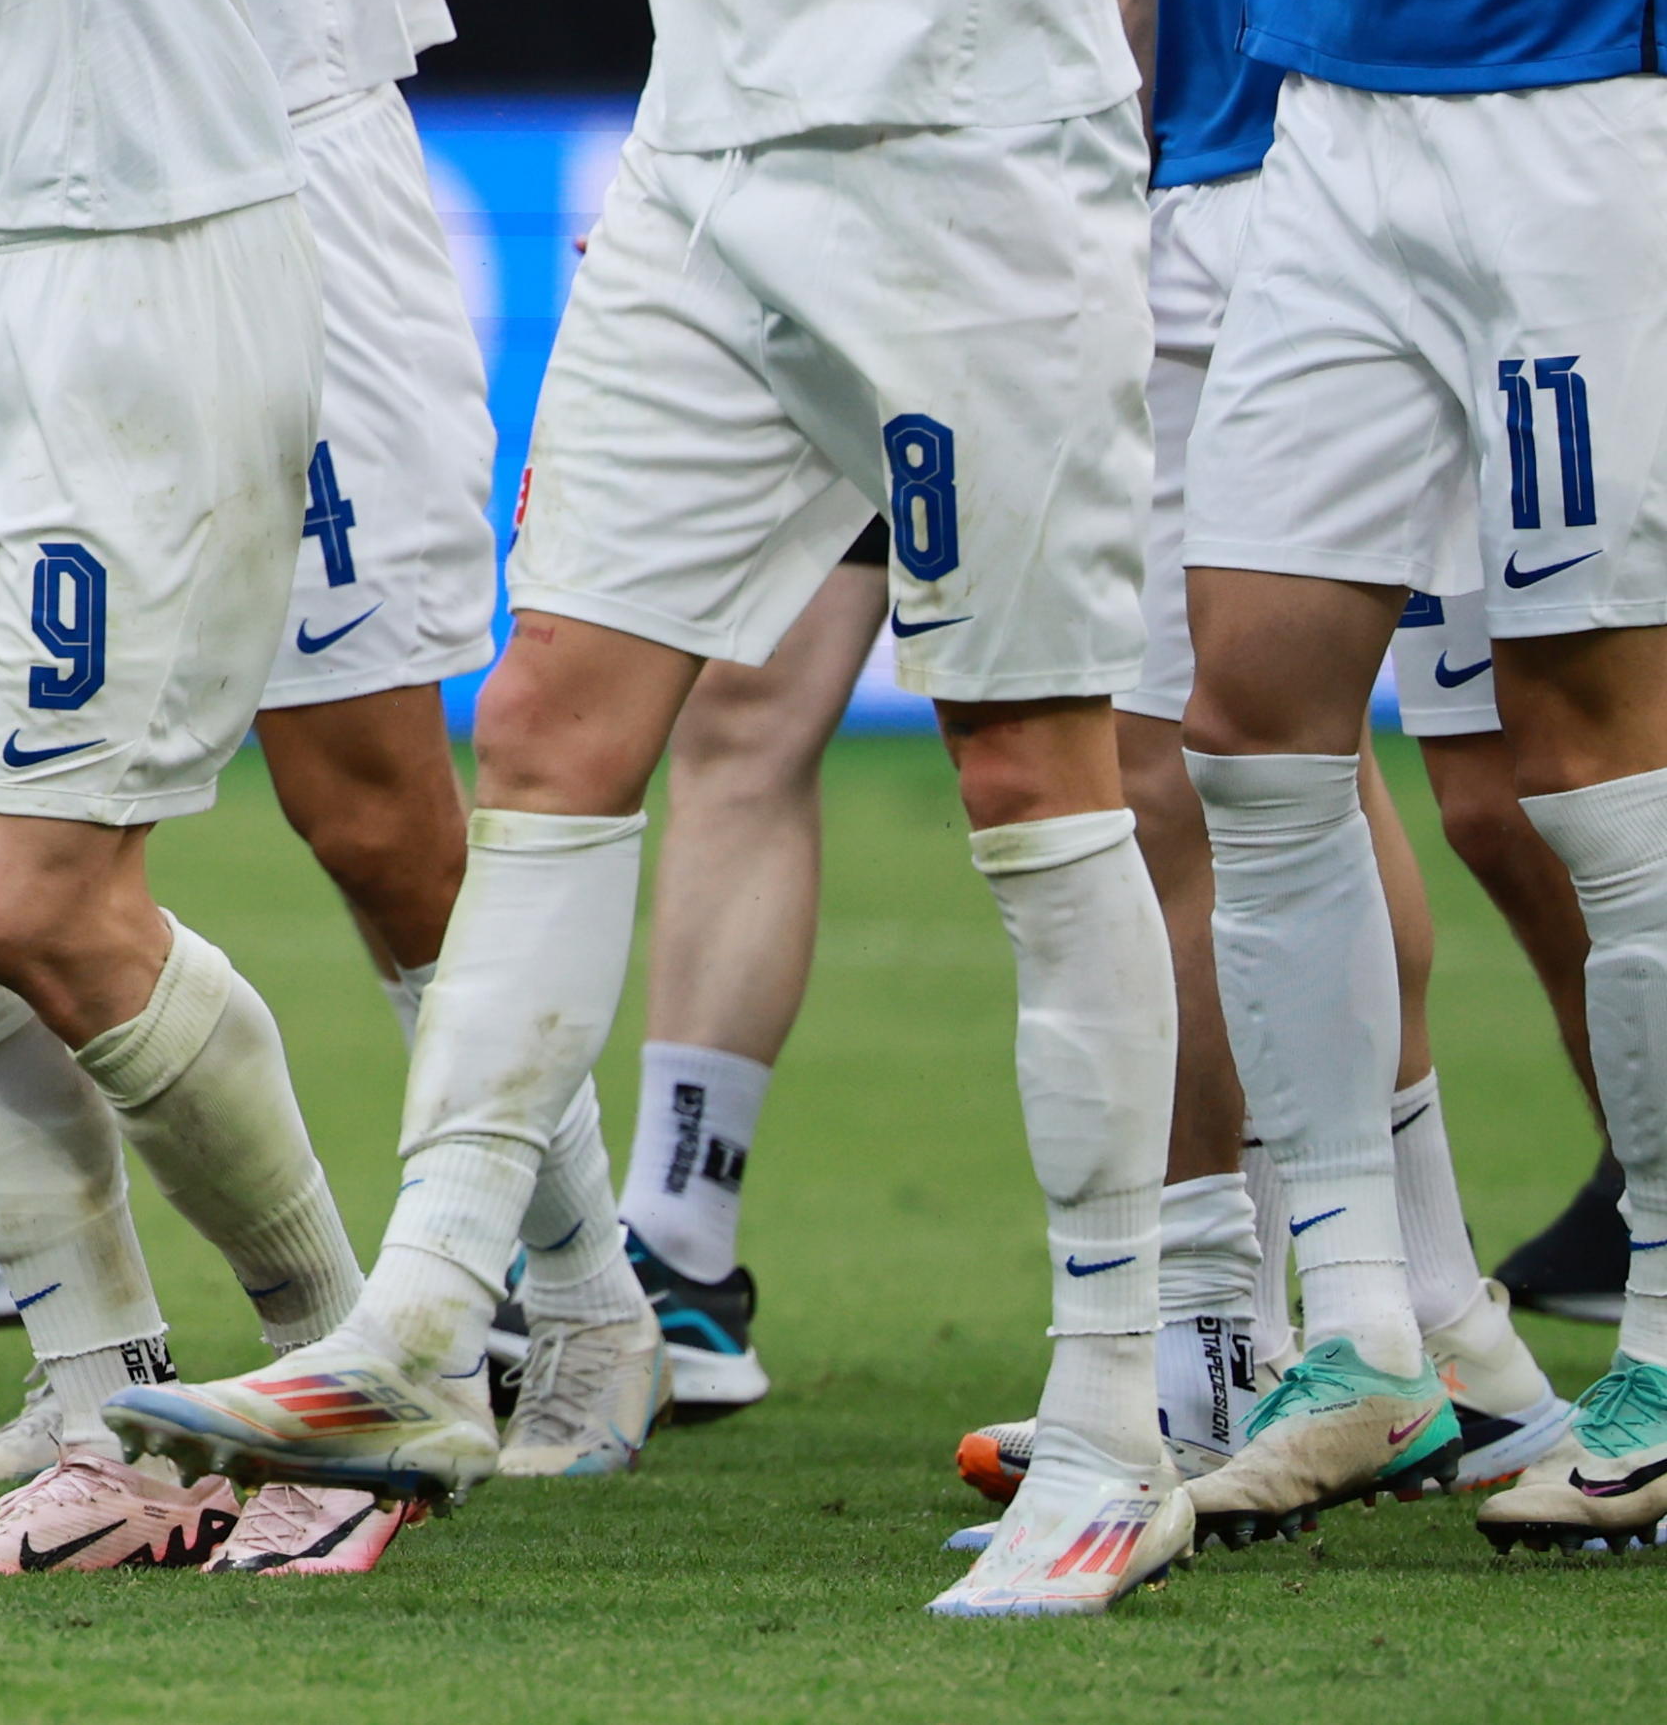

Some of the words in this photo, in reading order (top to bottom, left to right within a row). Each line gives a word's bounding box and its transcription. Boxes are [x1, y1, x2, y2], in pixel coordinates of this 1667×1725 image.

[883, 413, 959, 581] 8
[1499, 355, 1596, 530] 11
[28, 543, 107, 711] 9
[1096, 1499, 1162, 1519] F50
